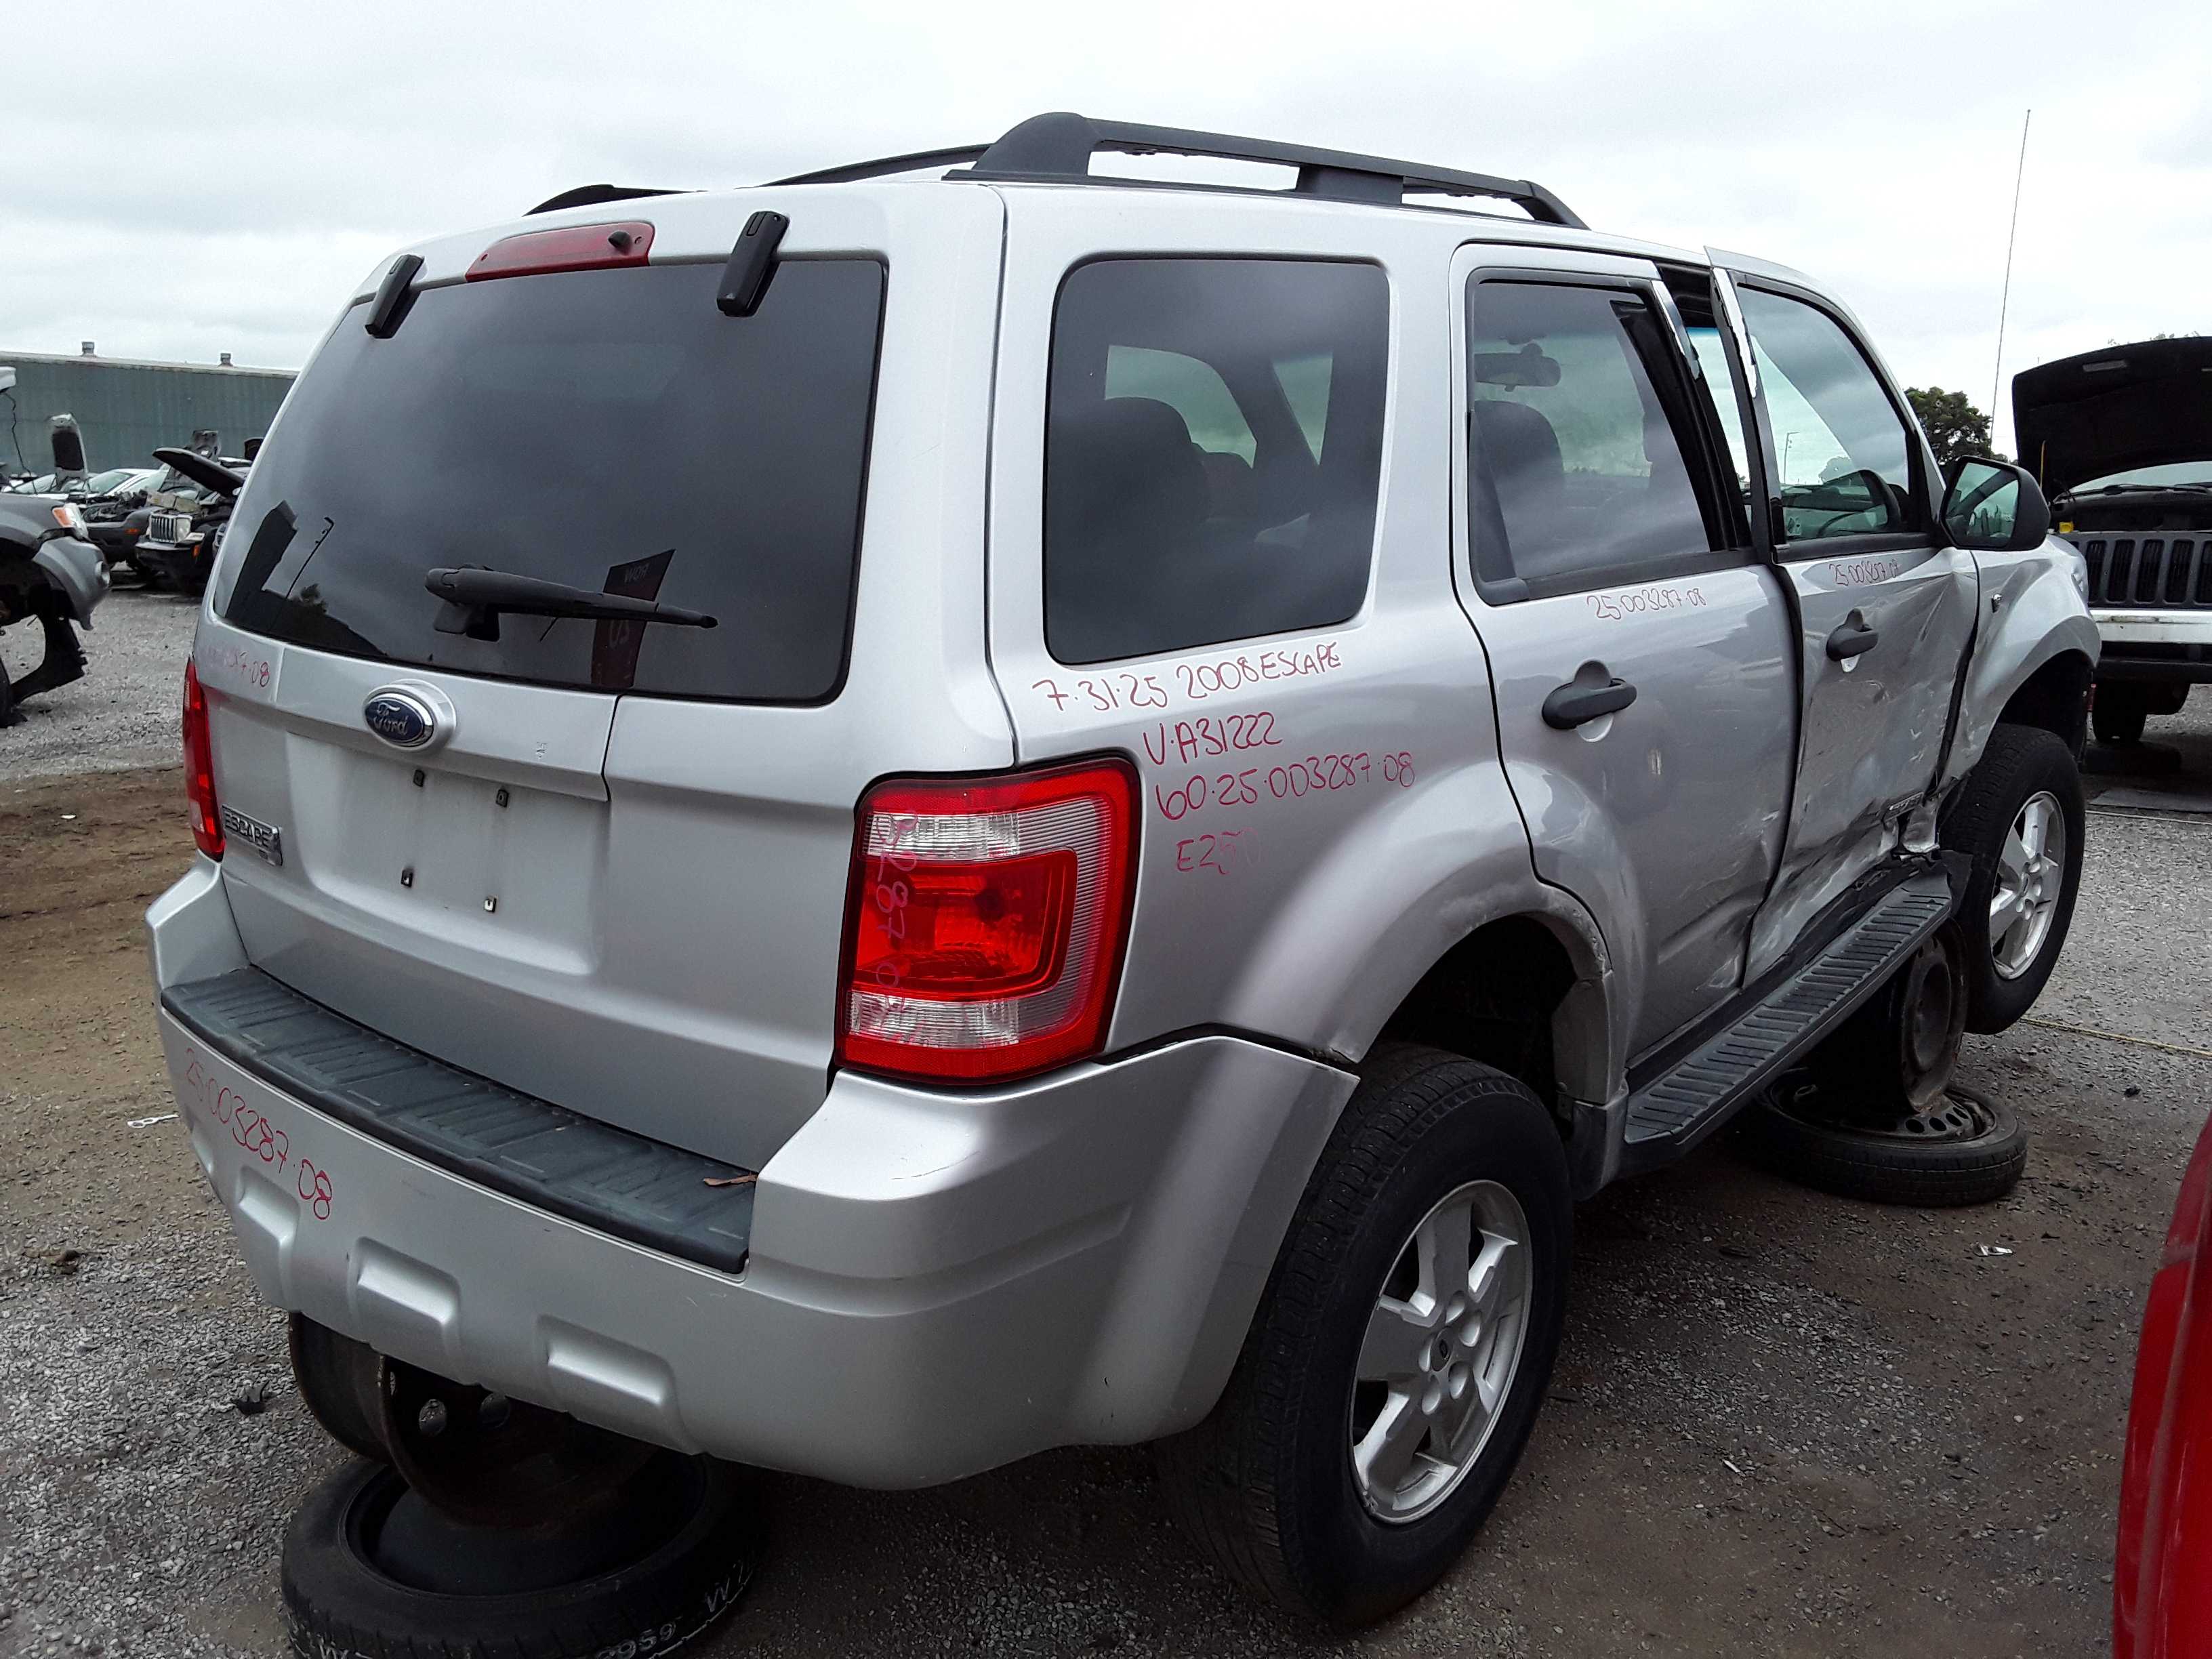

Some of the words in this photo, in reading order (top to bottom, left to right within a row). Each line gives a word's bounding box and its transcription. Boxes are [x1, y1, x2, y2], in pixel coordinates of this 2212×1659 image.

[1176, 655, 1260, 700] 2008
[1261, 641, 1343, 680] ESCAPE
[370, 701, 409, 736] Ford
[224, 810, 271, 848] ESCAPE
